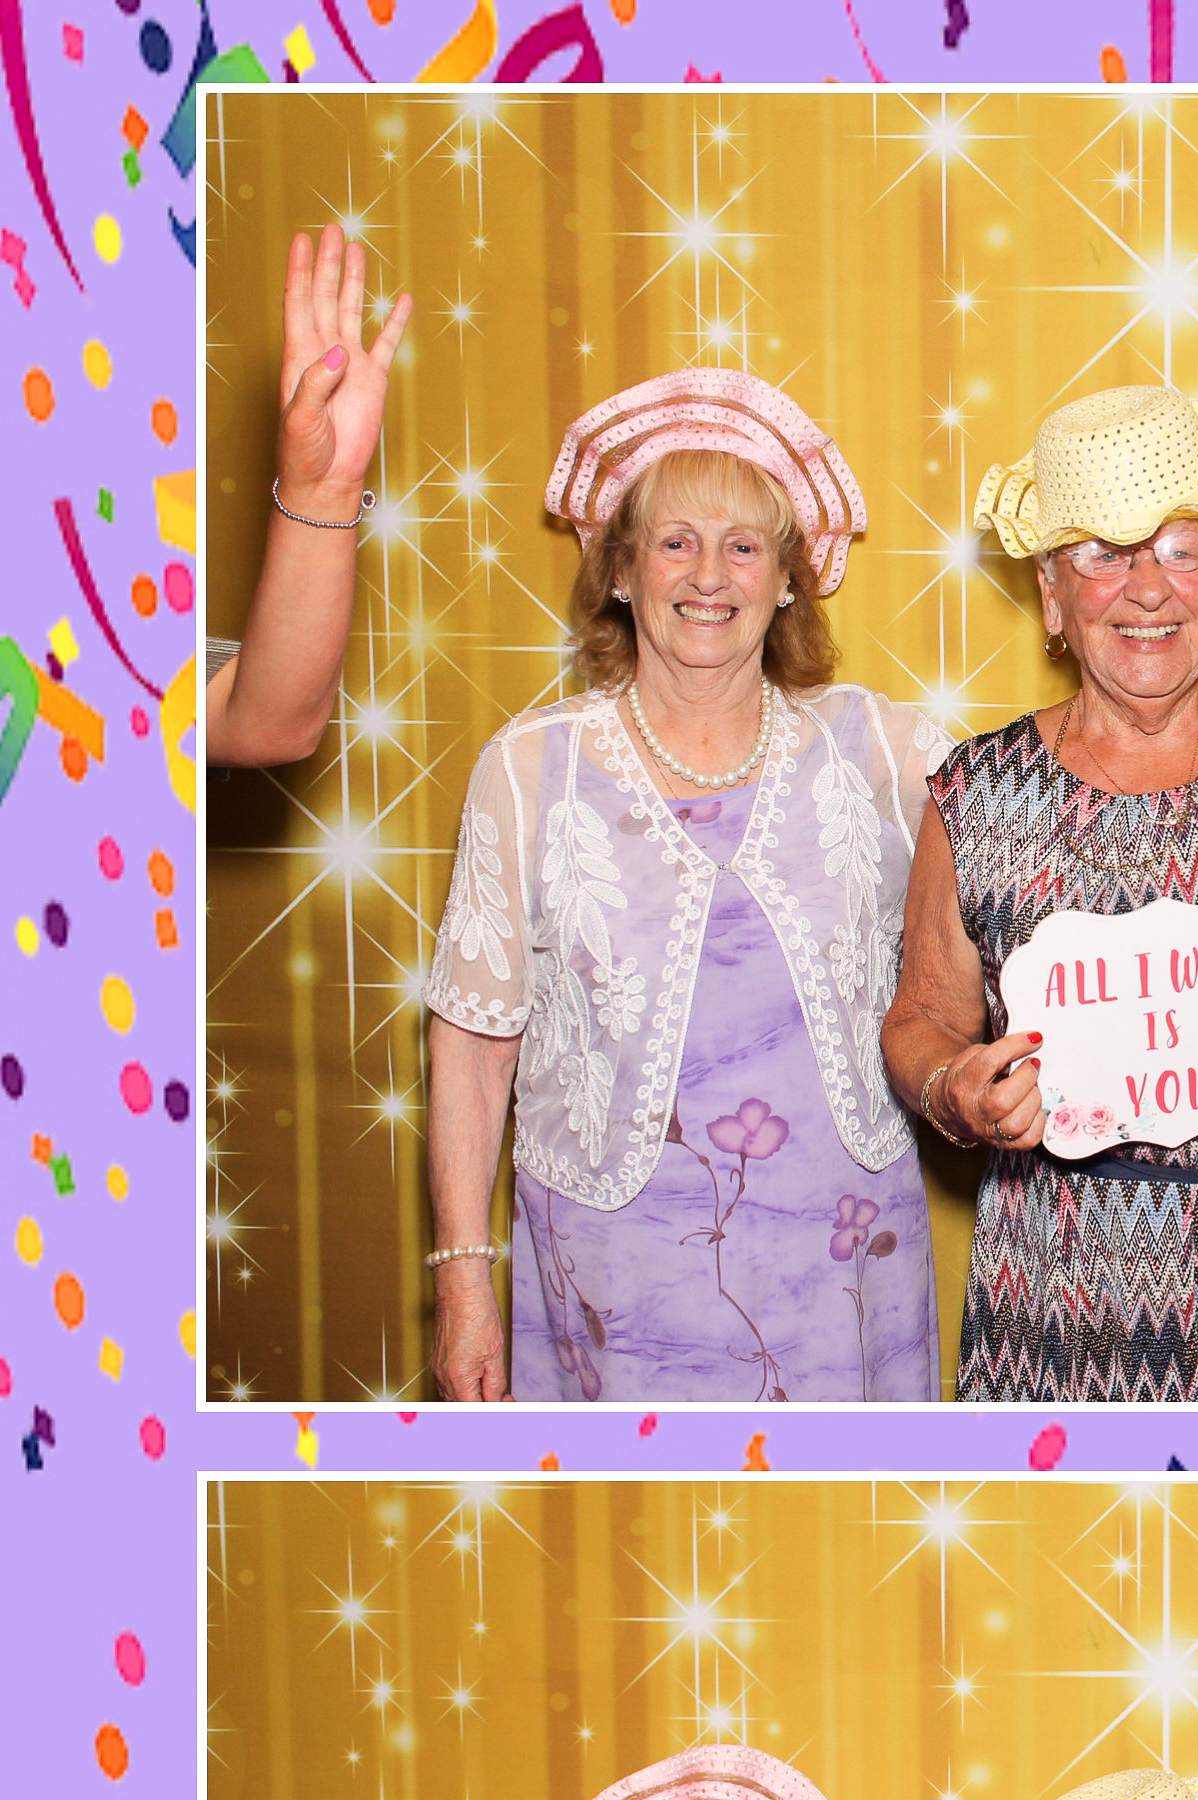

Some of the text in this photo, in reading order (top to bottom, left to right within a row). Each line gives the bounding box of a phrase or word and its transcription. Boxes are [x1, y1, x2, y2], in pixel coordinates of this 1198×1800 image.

[1045, 957, 1119, 1008] ALL
[1134, 952, 1153, 999] I
[1143, 1009, 1181, 1051] IS
